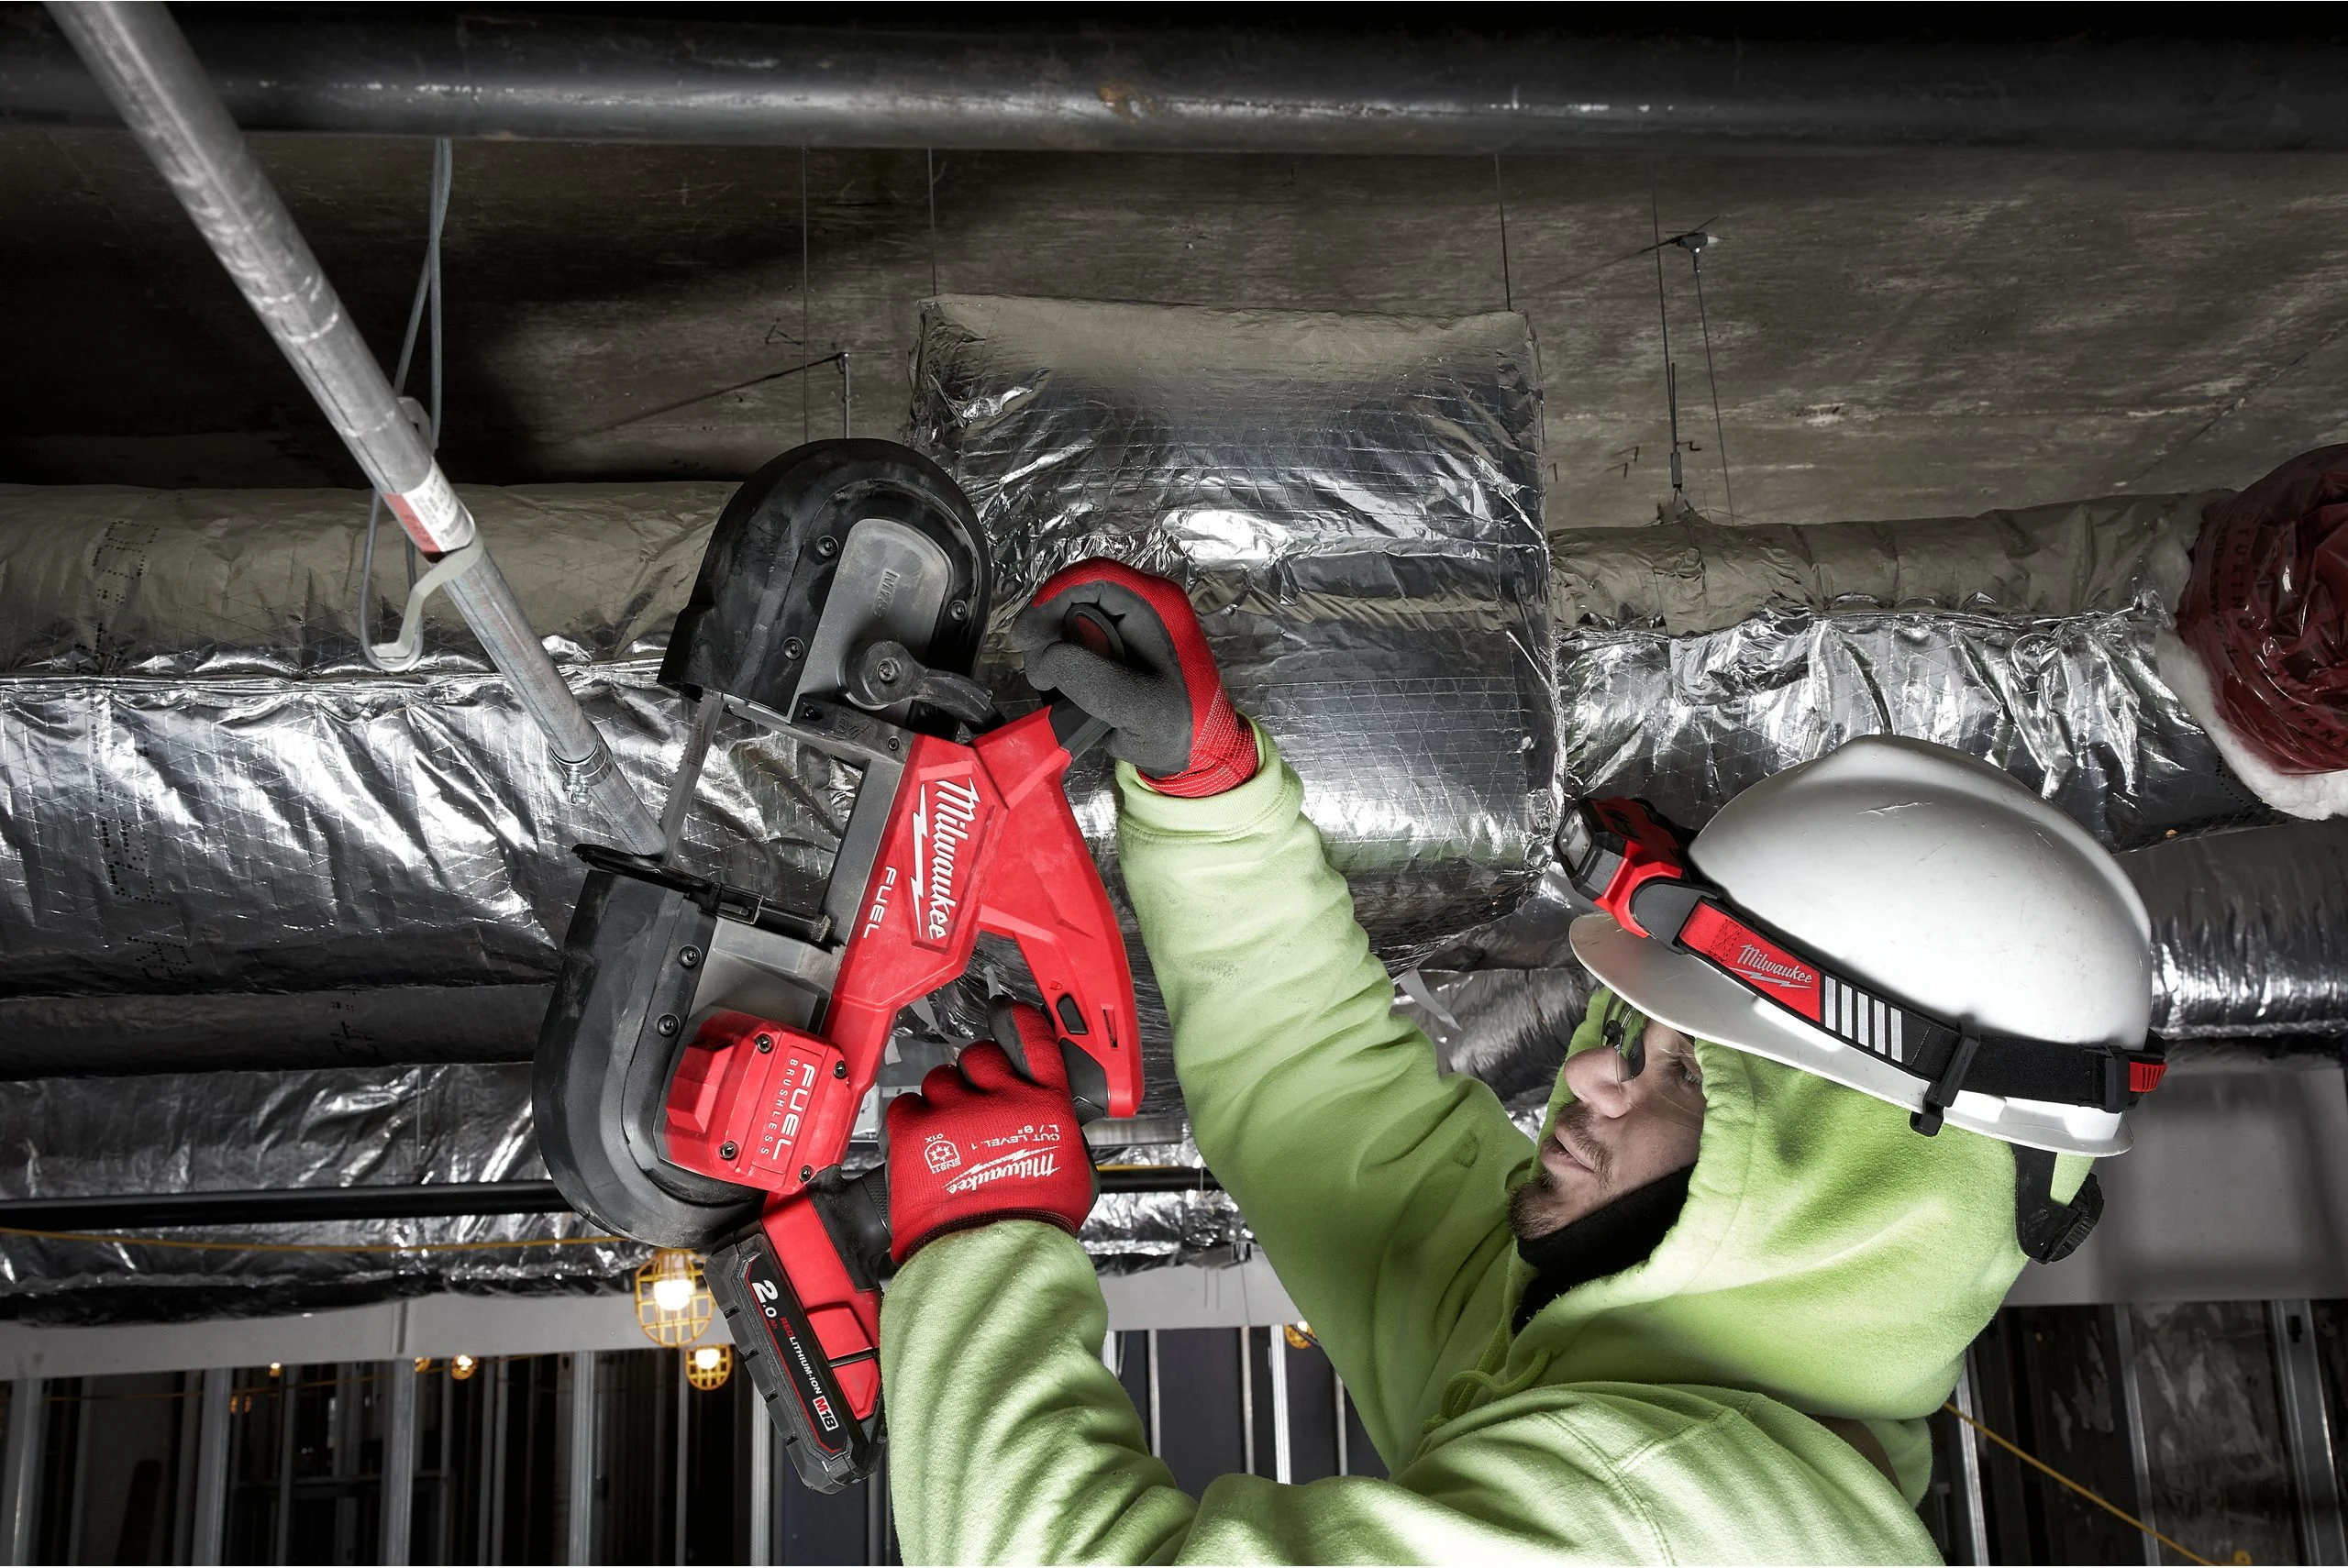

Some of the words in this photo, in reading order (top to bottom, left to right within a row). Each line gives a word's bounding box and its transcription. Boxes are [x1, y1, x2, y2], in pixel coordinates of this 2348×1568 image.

[929, 778, 980, 940] Milwaukee
[863, 866, 898, 939] FUEL
[1736, 944, 1812, 984] Milwaukee
[760, 1058, 799, 1155] BRUSHLESS
[772, 1063, 815, 1161] FUEL
[1033, 1132, 1059, 1142] CUT
[1048, 1124, 1059, 1133] L
[946, 1152, 1061, 1194] Milwaukee
[751, 1279, 778, 1319] 2.0
[814, 1397, 838, 1430] M18
